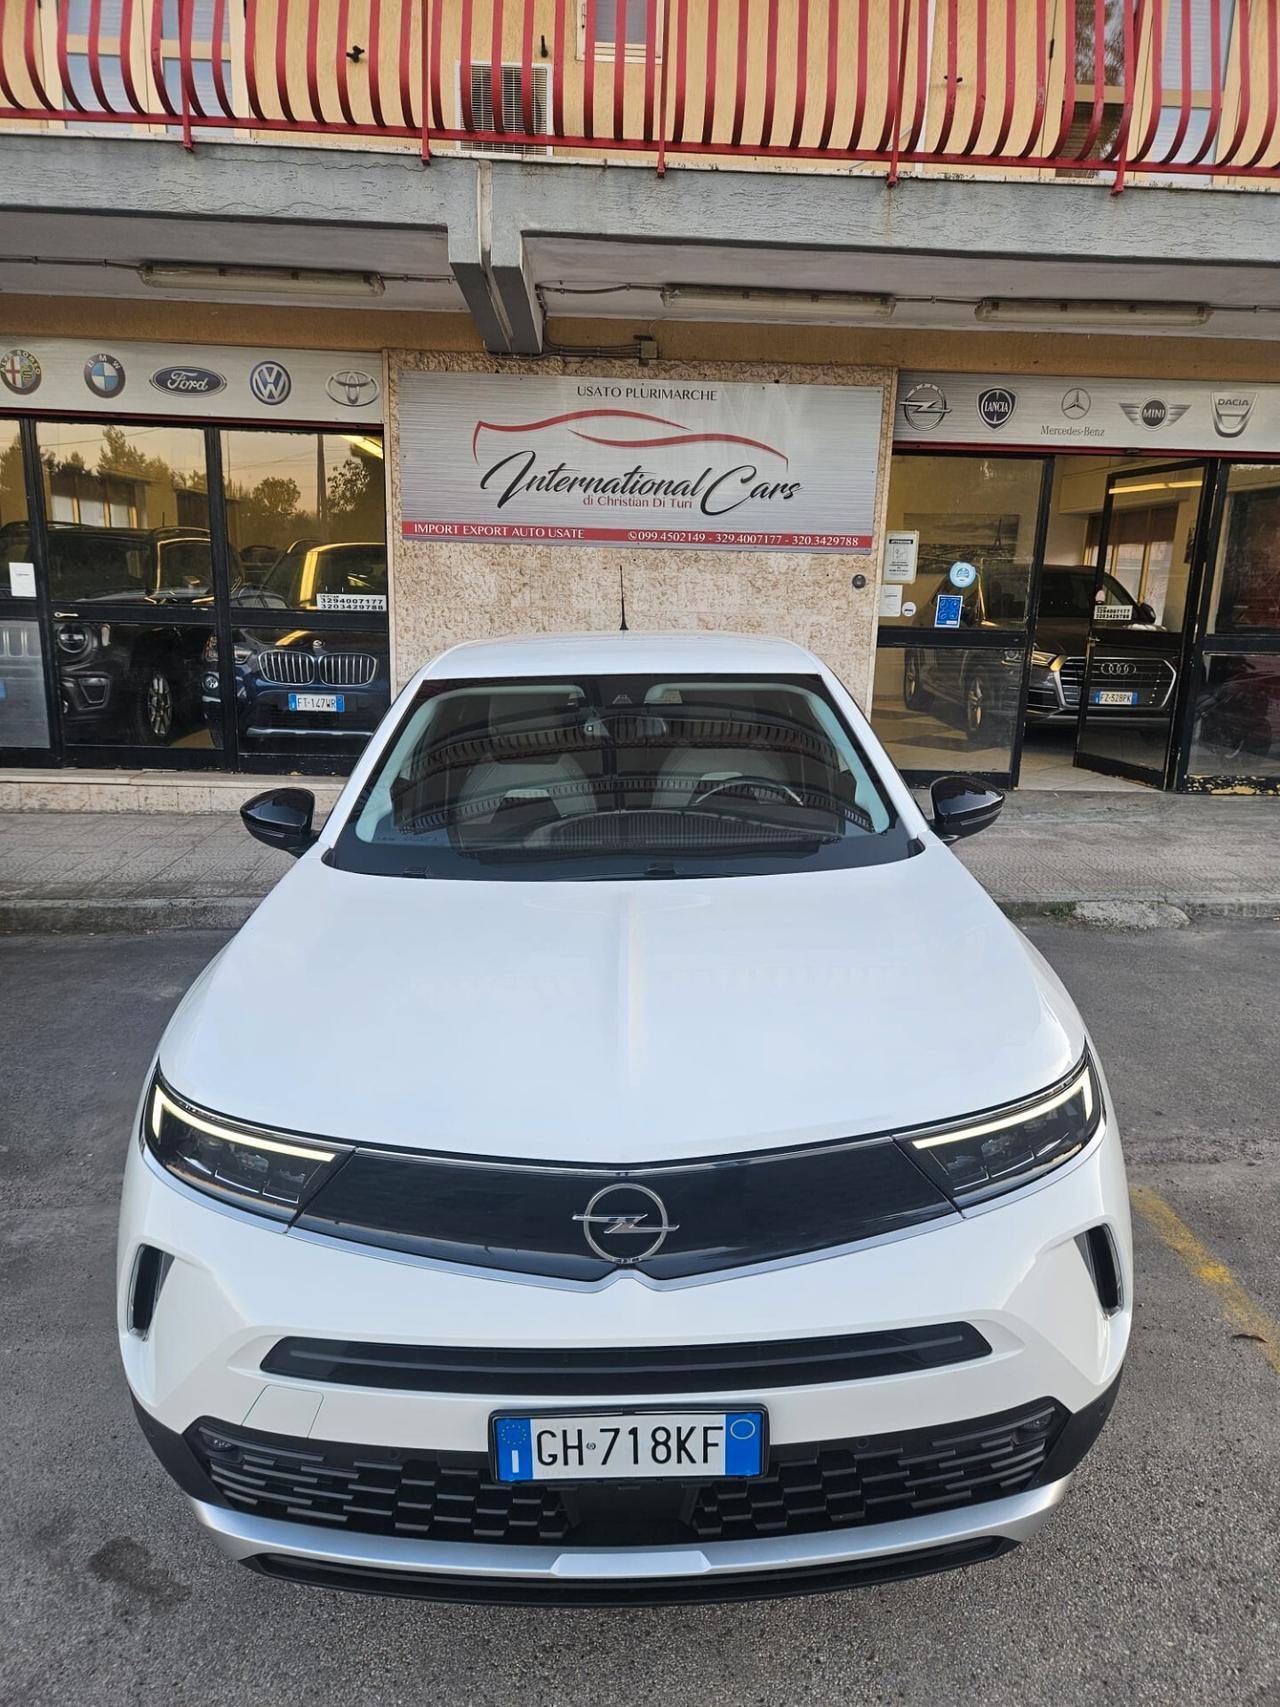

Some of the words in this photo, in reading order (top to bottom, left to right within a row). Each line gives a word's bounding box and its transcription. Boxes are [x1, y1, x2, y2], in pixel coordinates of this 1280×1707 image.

[88, 355, 121, 370] BMW
[167, 370, 208, 391] Ford
[577, 386, 622, 398] USATO
[625, 387, 718, 401] PLURIMARCHE
[984, 401, 1009, 413] LANCIA
[1217, 398, 1249, 406] DACIA
[1142, 408, 1165, 419] MINI
[1040, 425, 1105, 437] Mercedes-Benz
[480, 450, 713, 509] International
[700, 465, 803, 516] Cars
[583, 495, 593, 505] di
[597, 495, 649, 507] Christian
[653, 498, 665, 508] Di
[669, 498, 693, 509] Turi
[414, 522, 459, 535] IMPORT
[463, 524, 509, 537] EXPORT
[512, 526, 545, 538] AUTO
[548, 528, 585, 539] USATE
[638, 531, 706, 542] 099.4502149
[715, 533, 783, 545] 329.4007177
[792, 535, 859, 547] 320.3429788
